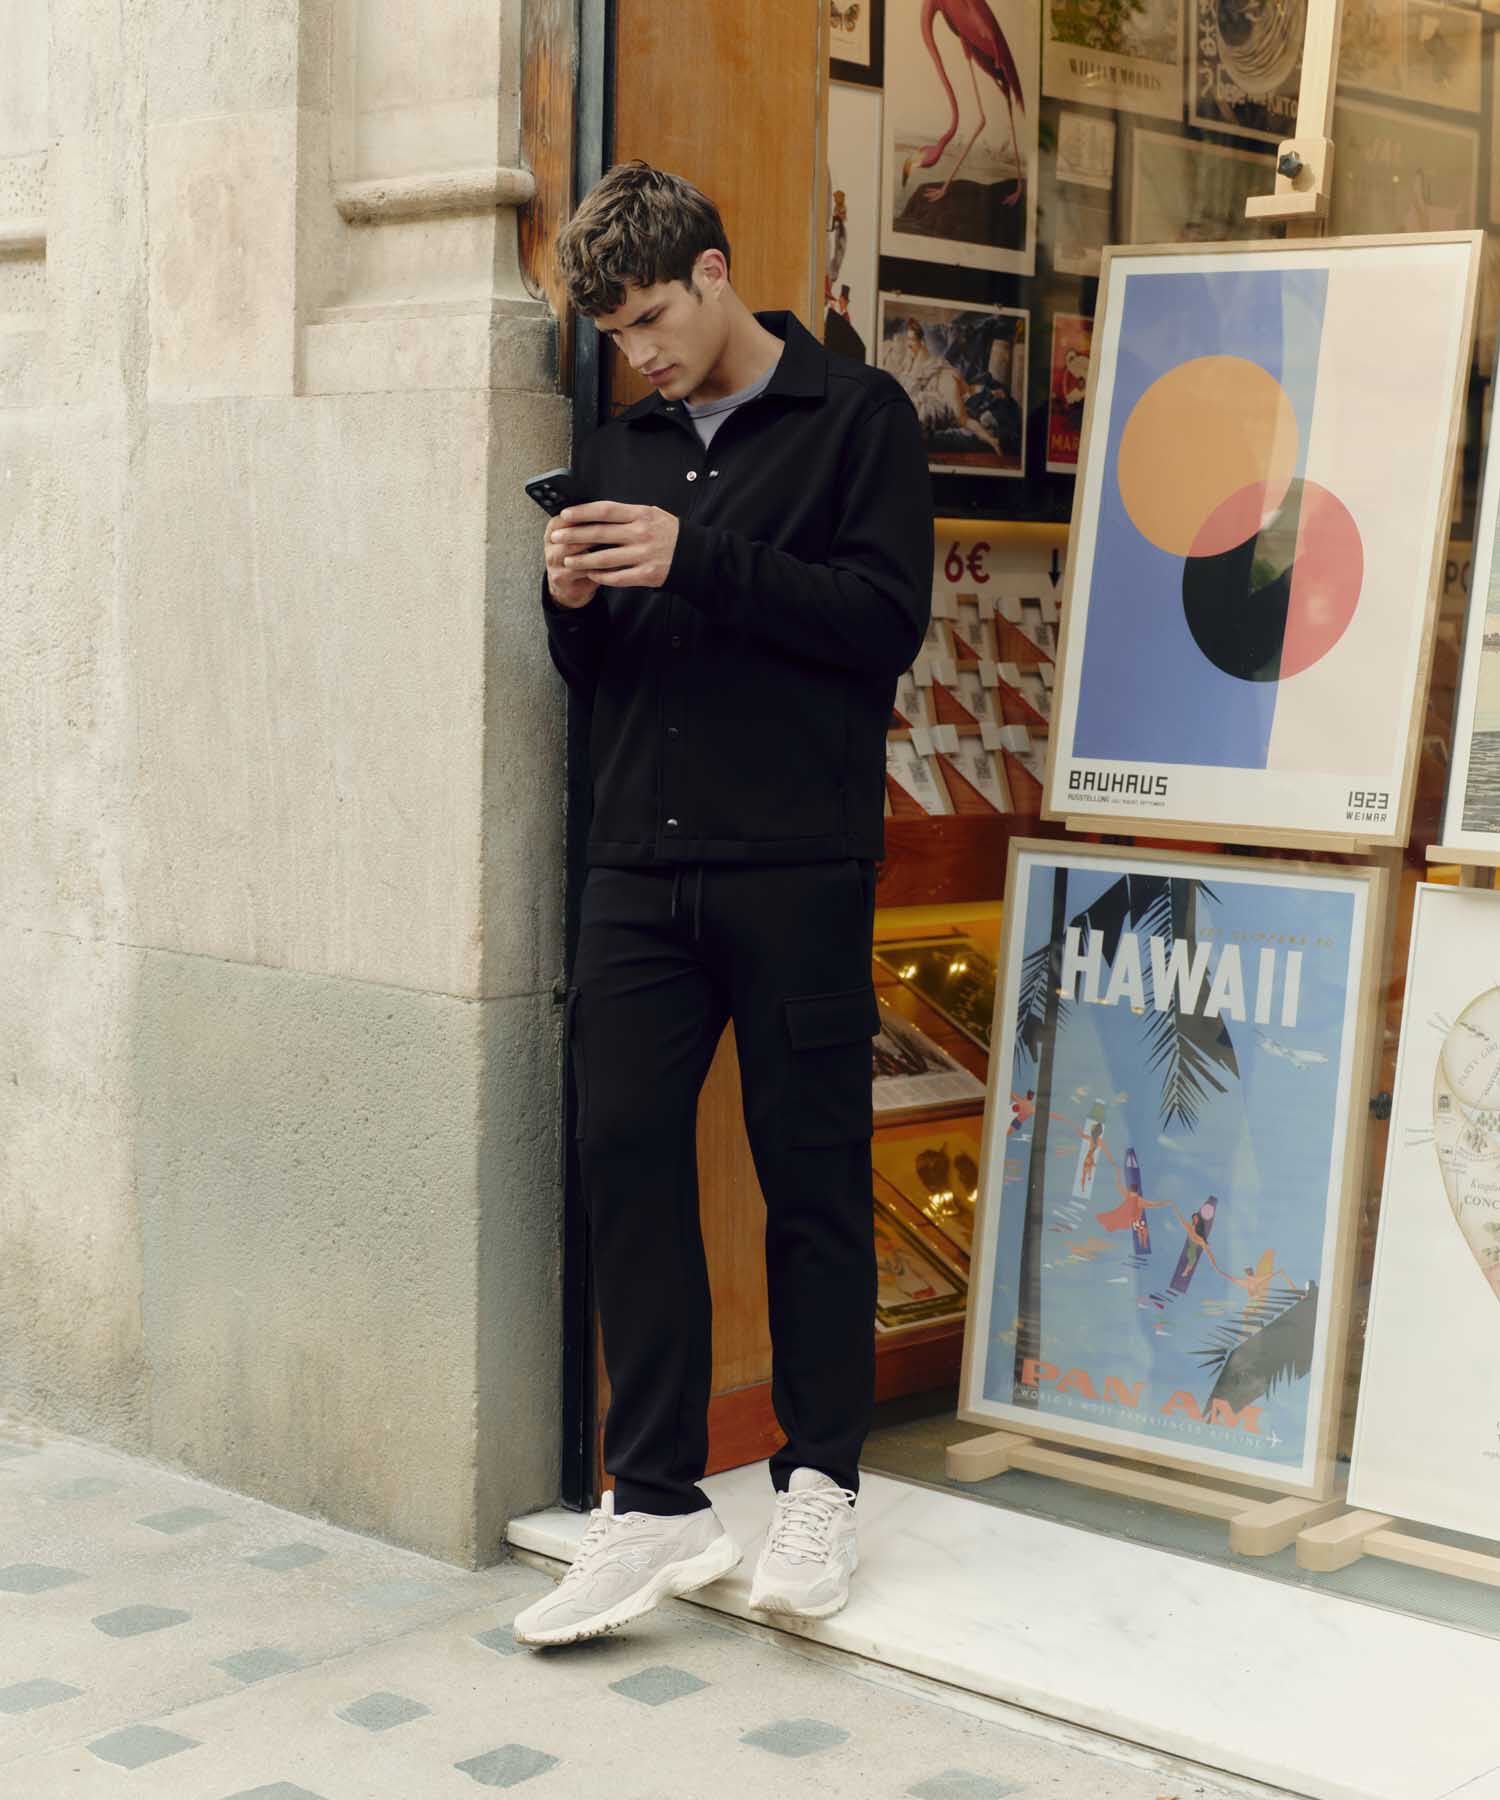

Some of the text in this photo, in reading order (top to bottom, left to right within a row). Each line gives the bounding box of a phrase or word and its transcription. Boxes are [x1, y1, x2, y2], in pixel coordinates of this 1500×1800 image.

[944, 541, 991, 584] 6€
[1069, 769, 1168, 796] BAUHAUS
[1347, 791, 1389, 809] 1923
[1346, 811, 1388, 823] WEIMAR
[1060, 926, 1303, 1028] HAWAII
[1022, 1358, 1265, 1434] PAN AM
